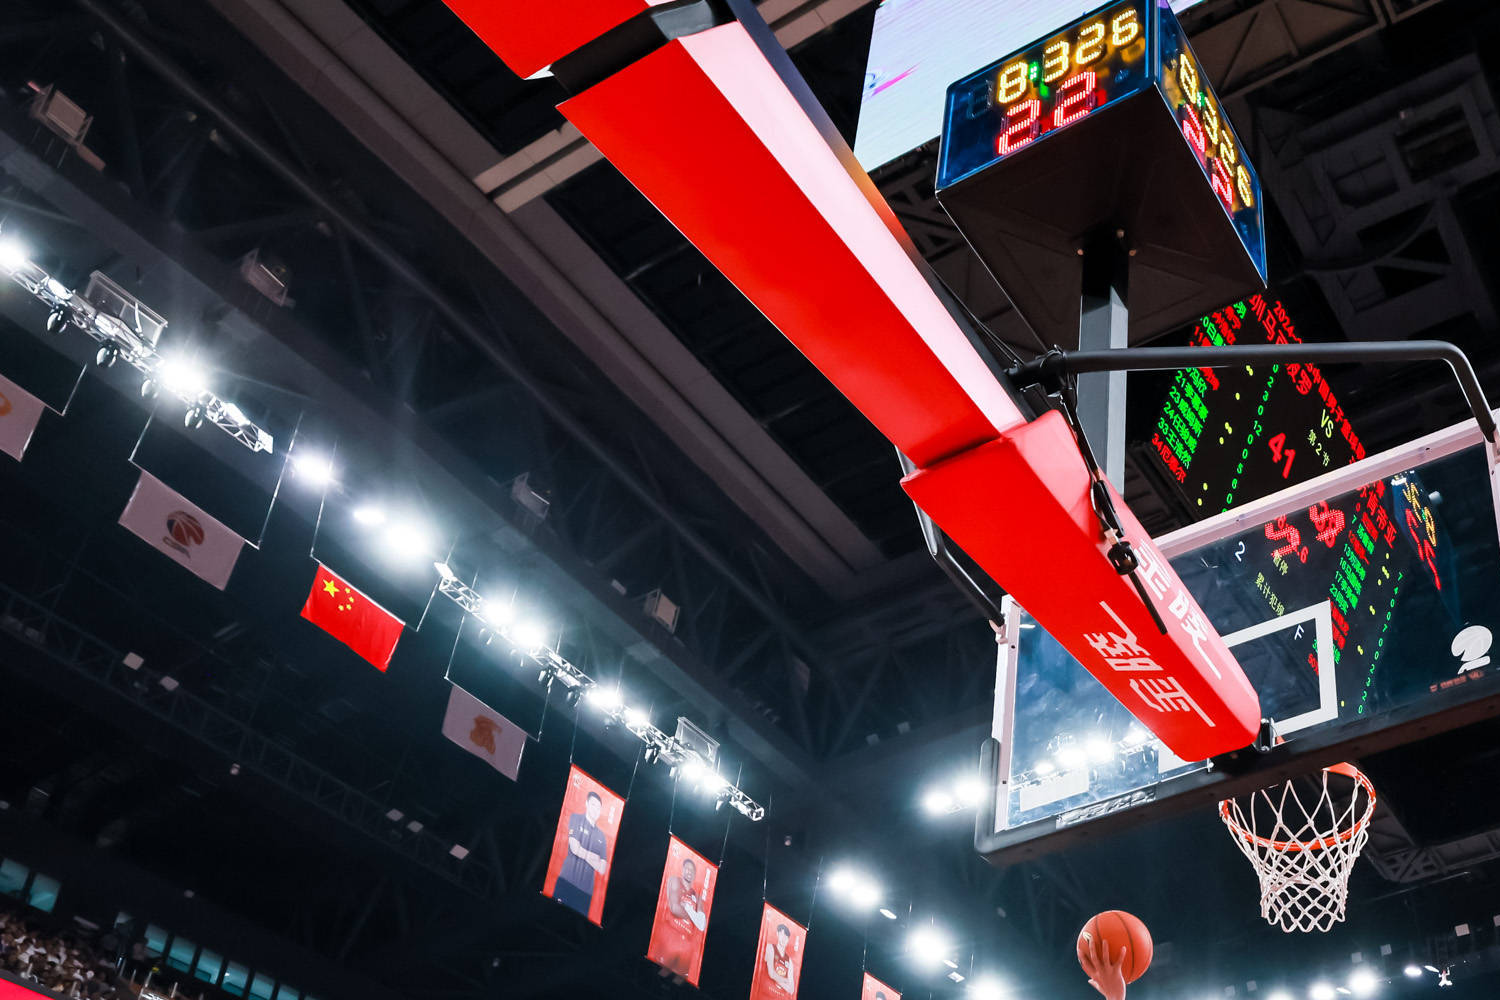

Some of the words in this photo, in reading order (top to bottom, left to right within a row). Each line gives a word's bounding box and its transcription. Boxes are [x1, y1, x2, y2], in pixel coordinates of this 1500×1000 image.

[998, 71, 1096, 155] 22
[1268, 432, 1296, 479] 41
[1320, 408, 1335, 439] VS
[1234, 541, 1246, 562] 2
[1293, 623, 1305, 641] F
